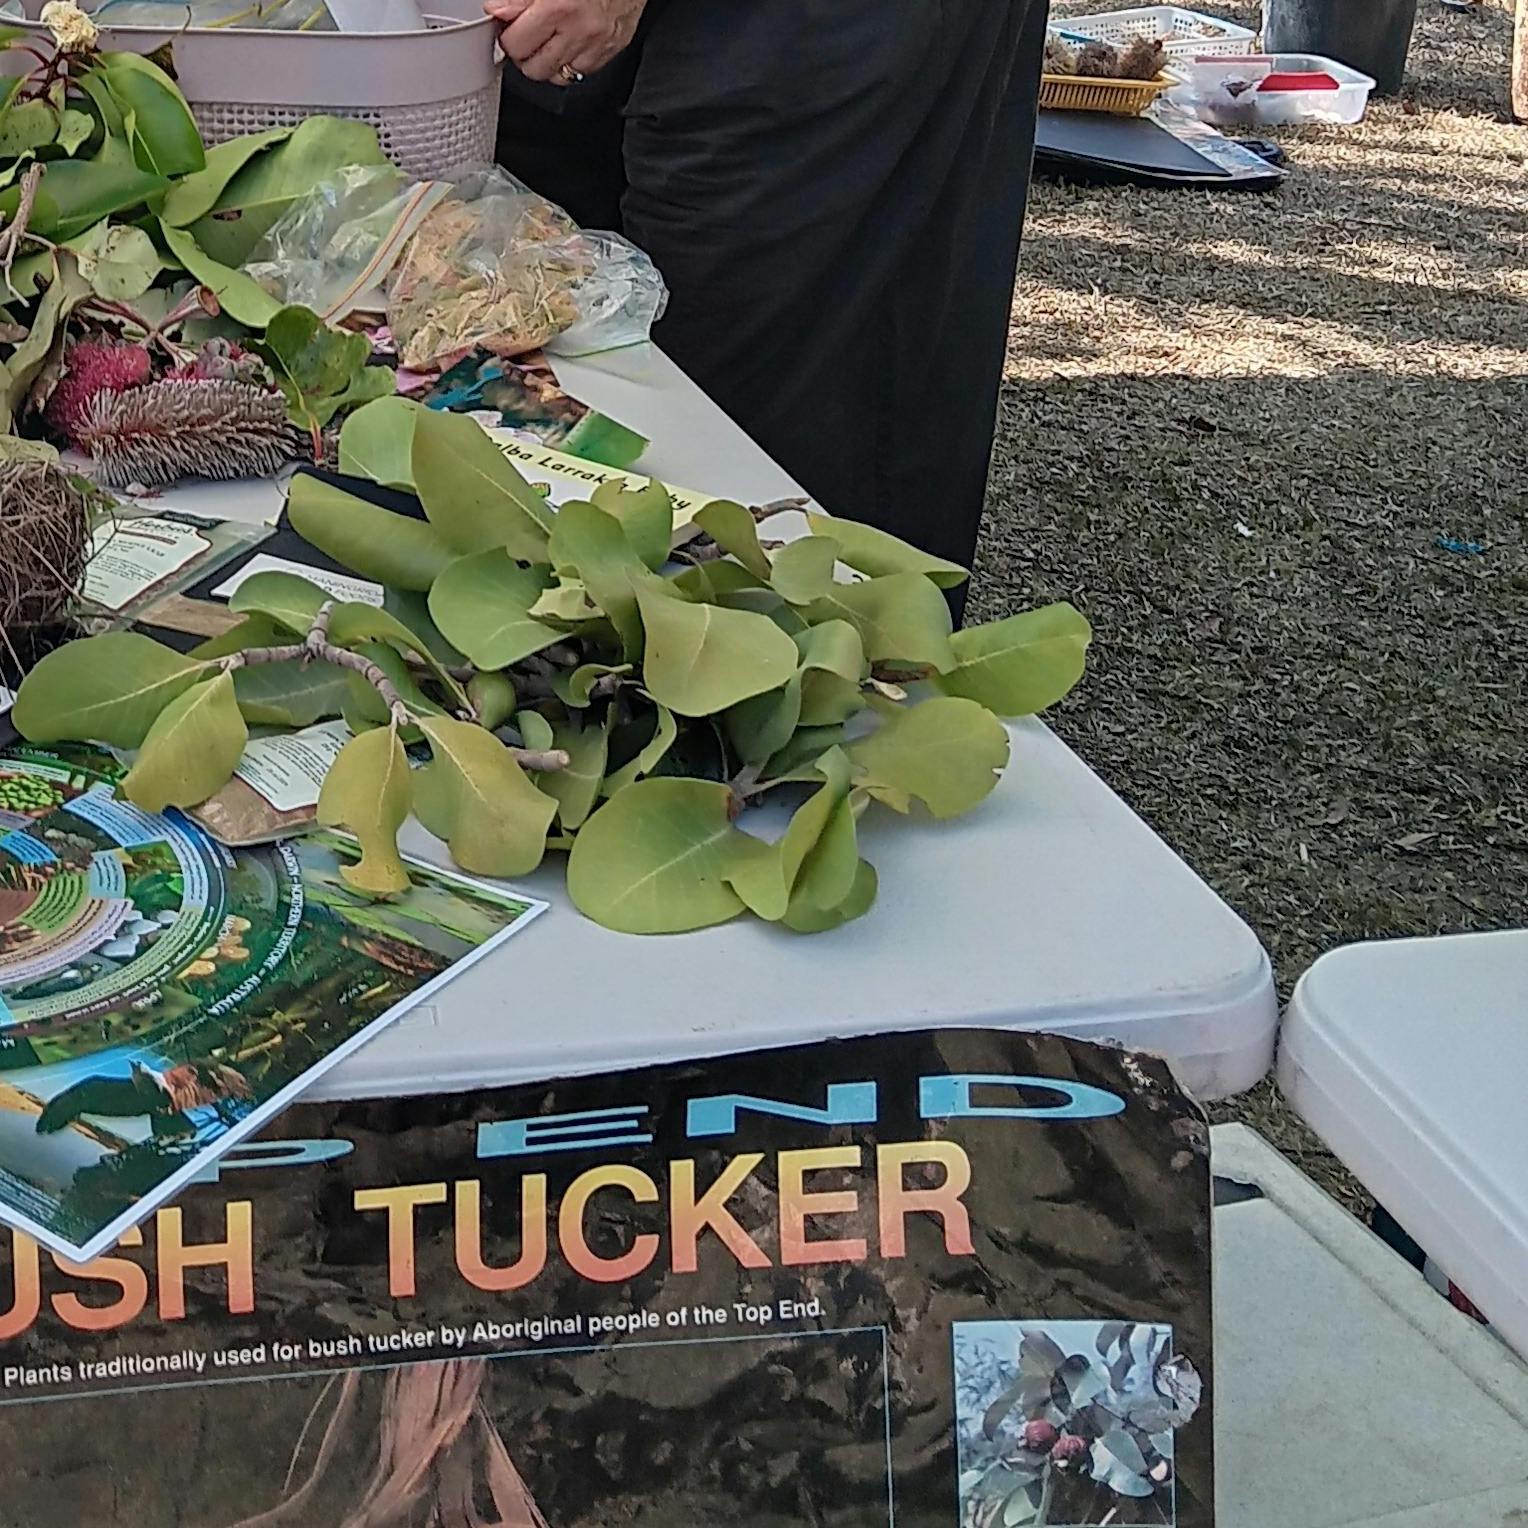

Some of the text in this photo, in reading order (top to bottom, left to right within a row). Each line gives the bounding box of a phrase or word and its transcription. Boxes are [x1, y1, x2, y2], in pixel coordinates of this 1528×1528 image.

[206, 974, 261, 1017] AUSTRALIA
[476, 1074, 1126, 1158] END
[354, 1140, 976, 1297] TUCKER
[3, 1298, 827, 1387] Plants traditionally used for bush tucker by Aboriginal people of the Top End.
